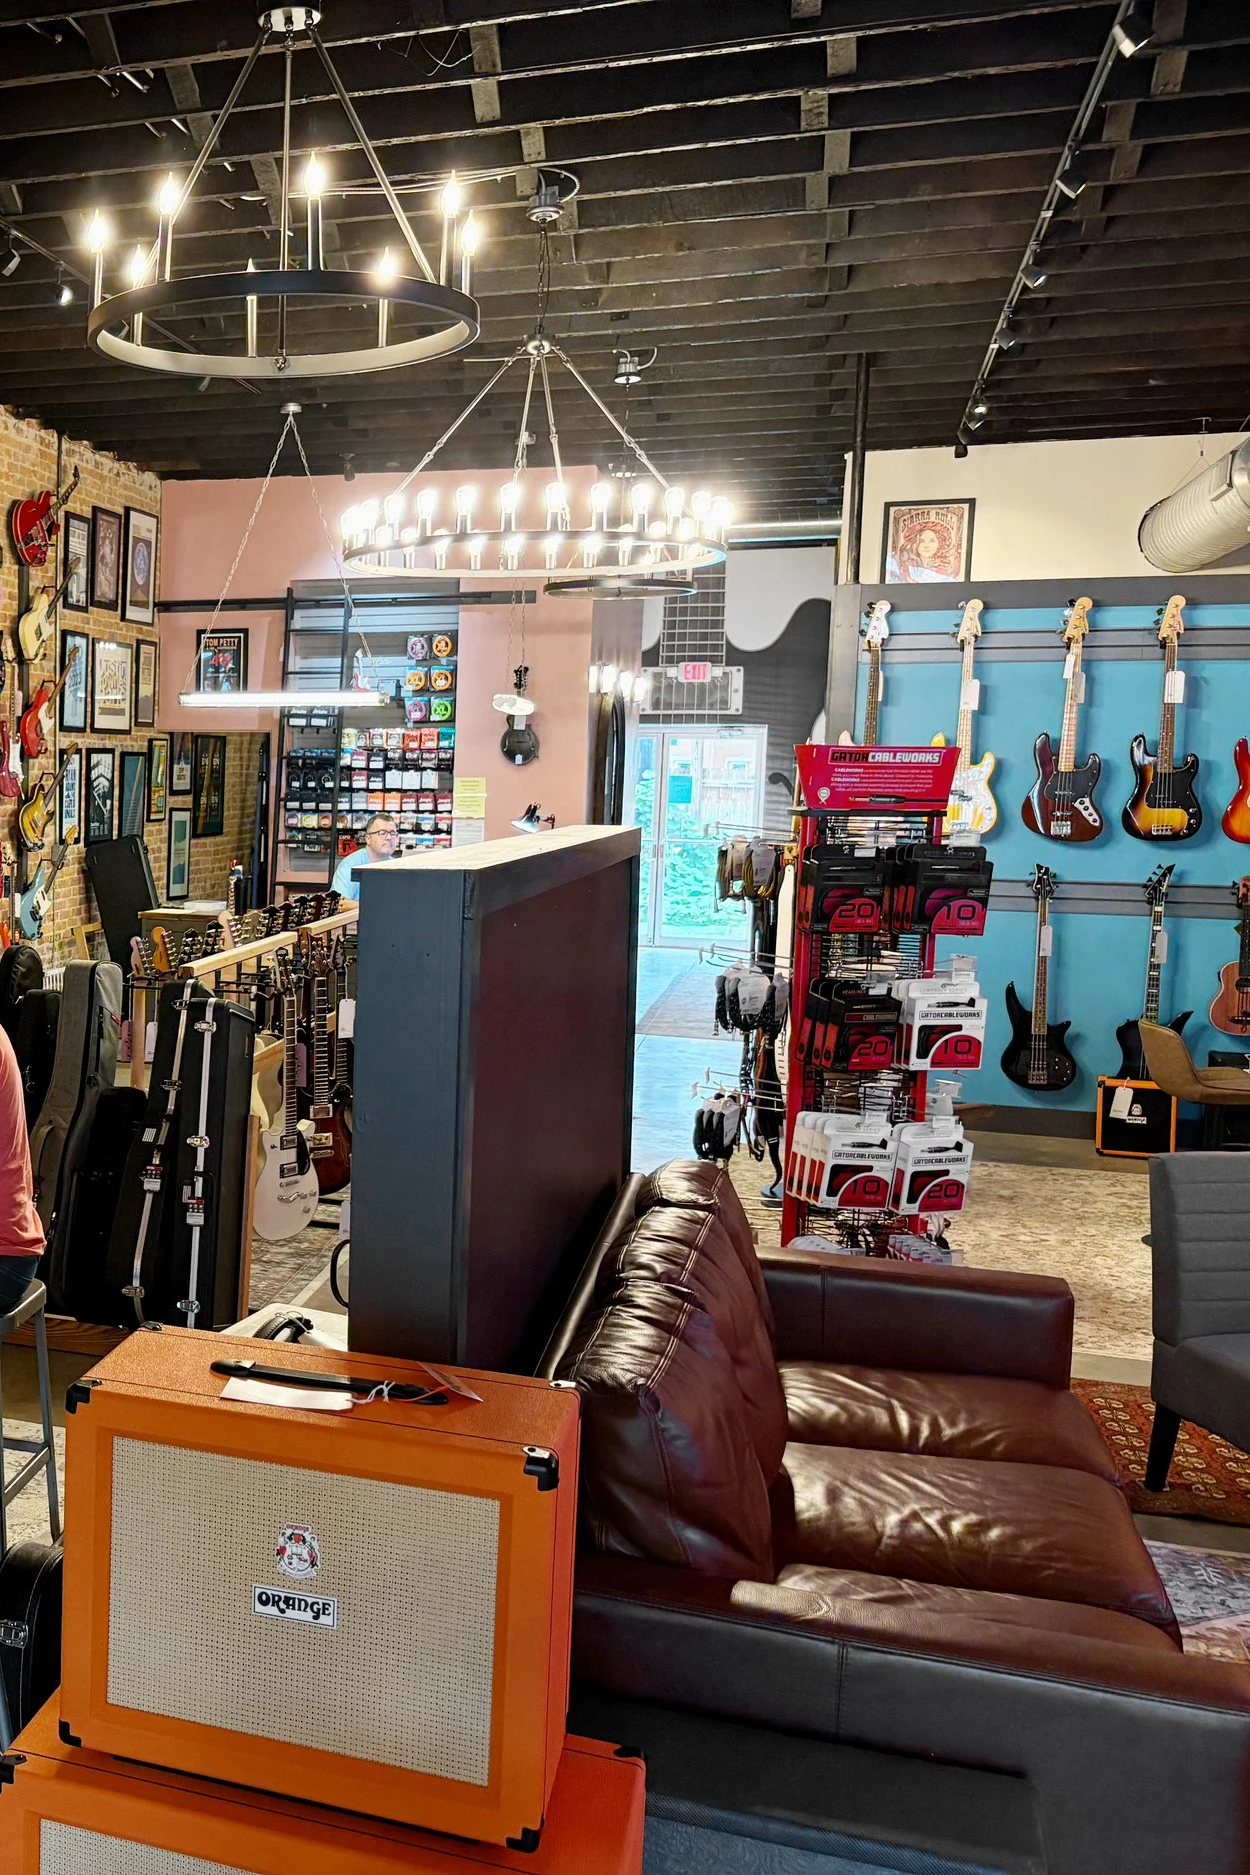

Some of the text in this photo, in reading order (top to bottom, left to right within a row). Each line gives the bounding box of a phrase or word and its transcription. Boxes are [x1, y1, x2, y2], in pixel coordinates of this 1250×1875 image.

[901, 510, 931, 533] SIERRA
[205, 638, 238, 647] TOM PETTY
[684, 664, 707, 680] EXIT
[838, 903, 874, 918] 20
[944, 904, 976, 920] 10
[857, 1041, 889, 1056] 20
[943, 1037, 973, 1055] 10
[852, 1179, 881, 1195] 10
[927, 1183, 960, 1199] 20
[257, 1591, 331, 1620] ORANGE
